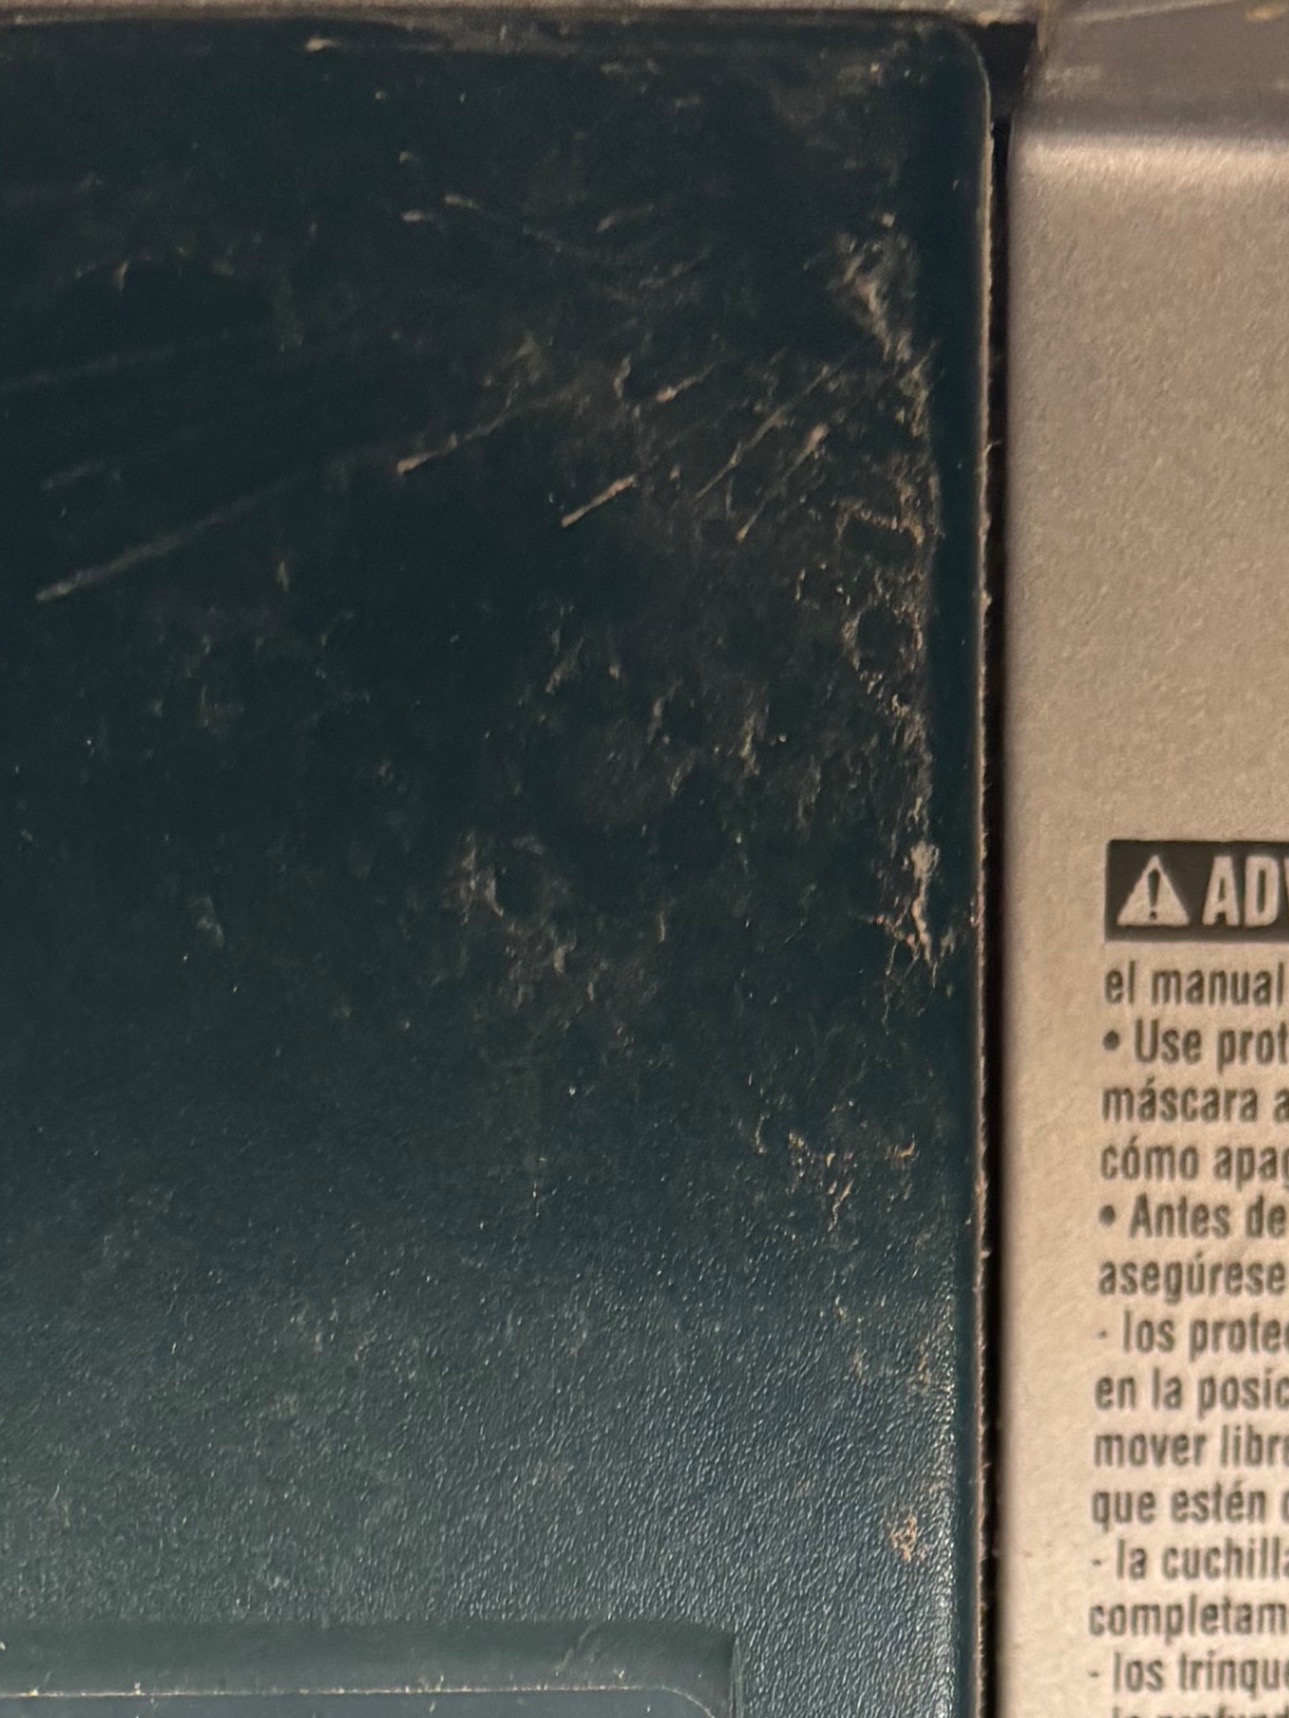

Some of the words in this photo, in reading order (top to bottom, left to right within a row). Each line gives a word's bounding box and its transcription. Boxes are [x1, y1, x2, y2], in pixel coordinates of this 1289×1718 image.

[1105, 960, 1136, 1004] el
[1152, 961, 1285, 1006] manual
[1135, 1017, 1203, 1064] Use
[1103, 1076, 1259, 1122] máscara
[1101, 1134, 1200, 1180] cómo
[1130, 1192, 1232, 1238] Antes
[1245, 1193, 1288, 1239] de
[1099, 1250, 1287, 1305] asegúrese
[1124, 1309, 1176, 1353] los
